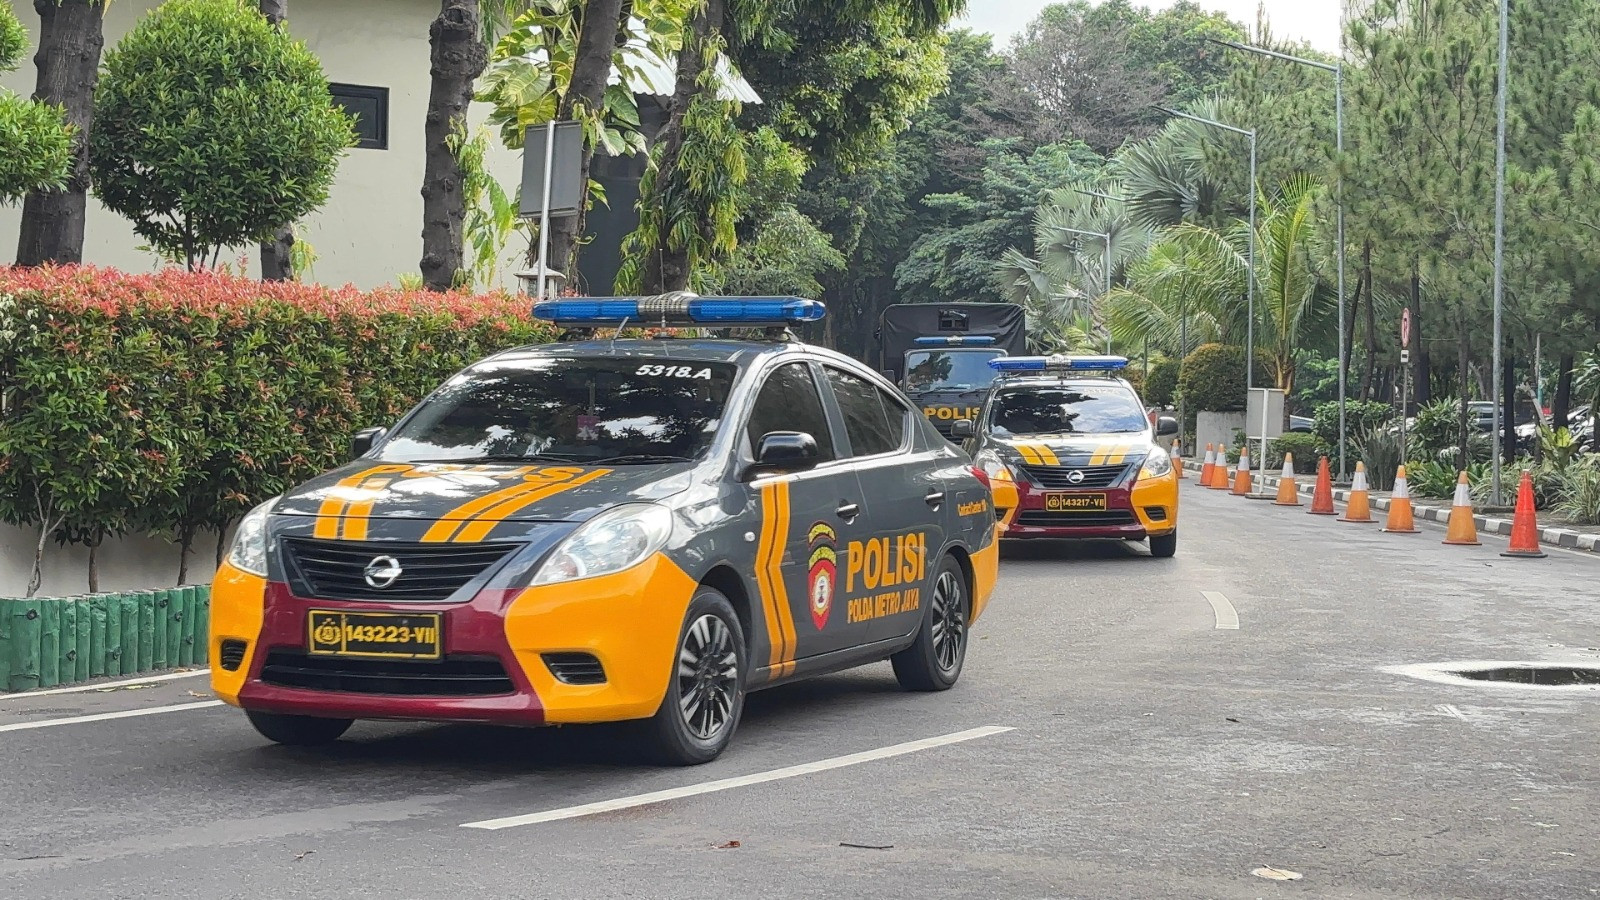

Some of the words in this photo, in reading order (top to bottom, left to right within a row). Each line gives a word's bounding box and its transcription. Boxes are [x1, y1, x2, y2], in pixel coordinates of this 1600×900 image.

[635, 364, 712, 380] 5318.A
[846, 532, 925, 593] POLISI
[847, 596, 874, 624] POLDA
[874, 591, 901, 618] METRO
[901, 588, 919, 613] JAYA
[345, 624, 436, 644] 143223-VII
